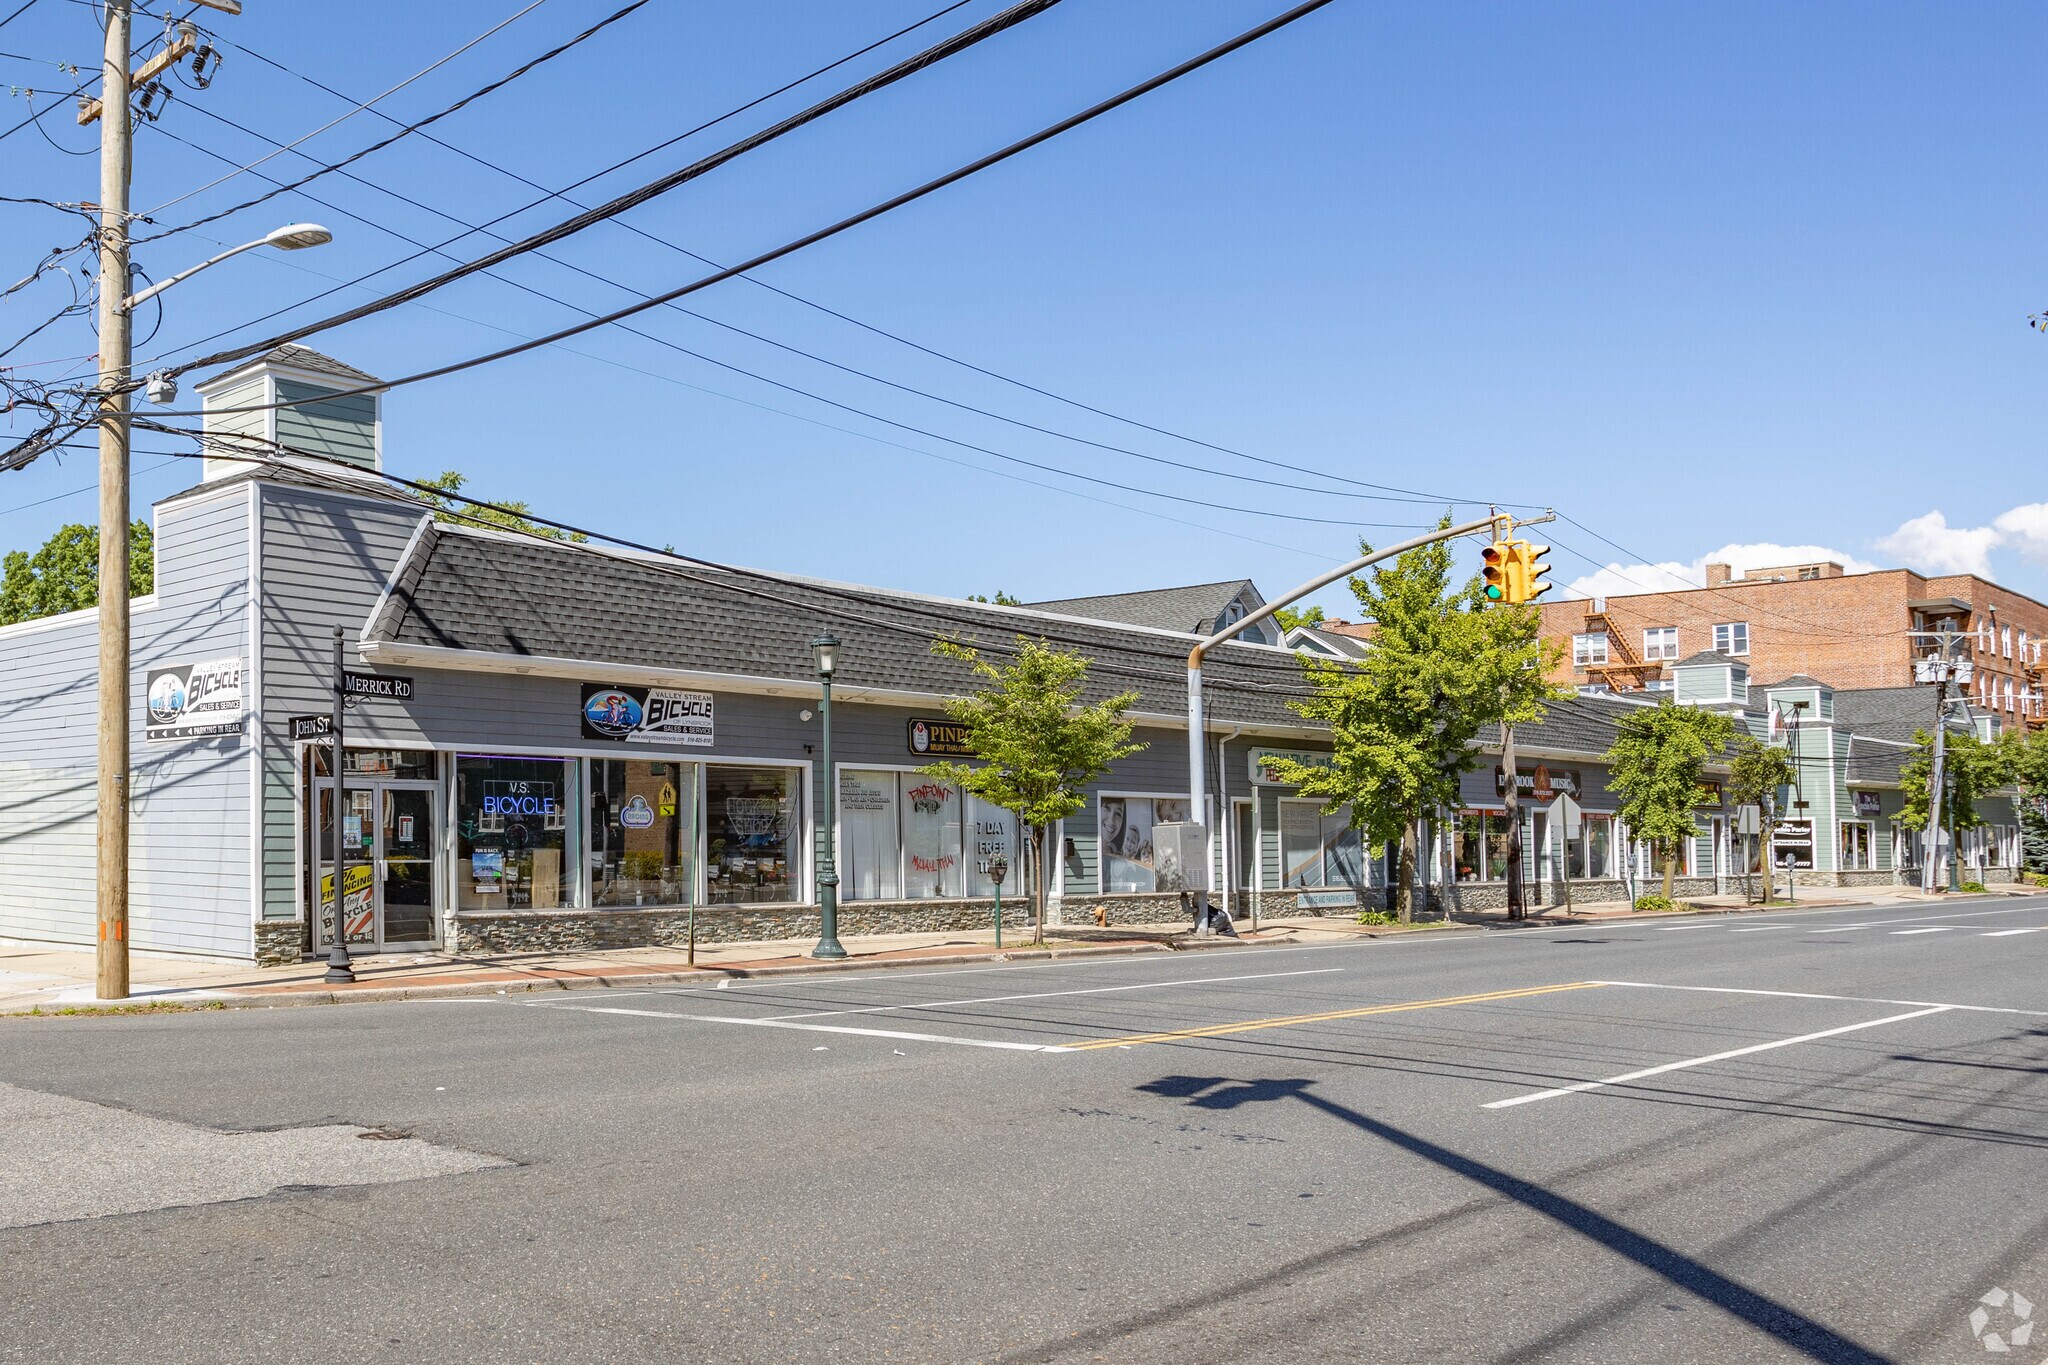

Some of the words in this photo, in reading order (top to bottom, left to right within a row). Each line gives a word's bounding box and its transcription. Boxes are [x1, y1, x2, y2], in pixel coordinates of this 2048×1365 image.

[187, 670, 239, 708] BICYCLE
[345, 674, 392, 695] MERRICK
[394, 680, 411, 697] RD
[655, 691, 683, 701] VALLEY
[684, 694, 712, 702] STREAM
[199, 702, 214, 712] SALES
[215, 702, 220, 710] &
[220, 700, 240, 710] SERVICE
[645, 698, 712, 727] BICYCLE
[193, 725, 217, 736] PARKING
[217, 725, 224, 733] IN
[224, 723, 240, 733] REAR
[295, 719, 316, 739] JOHN
[317, 716, 331, 733] ST
[663, 725, 682, 733] SALES
[509, 781, 530, 794] V.S.
[1549, 777, 1571, 789] MUSIC
[908, 784, 954, 802] PINPOINT
[484, 796, 555, 814] BICYCLE
[985, 821, 1005, 835] DAY
[977, 841, 1005, 855] FREE
[1299, 896, 1318, 905] ENTRANCE
[1326, 895, 1342, 903] PARKING
[1345, 894, 1355, 903] REAR
[322, 901, 373, 929] BYCLE
